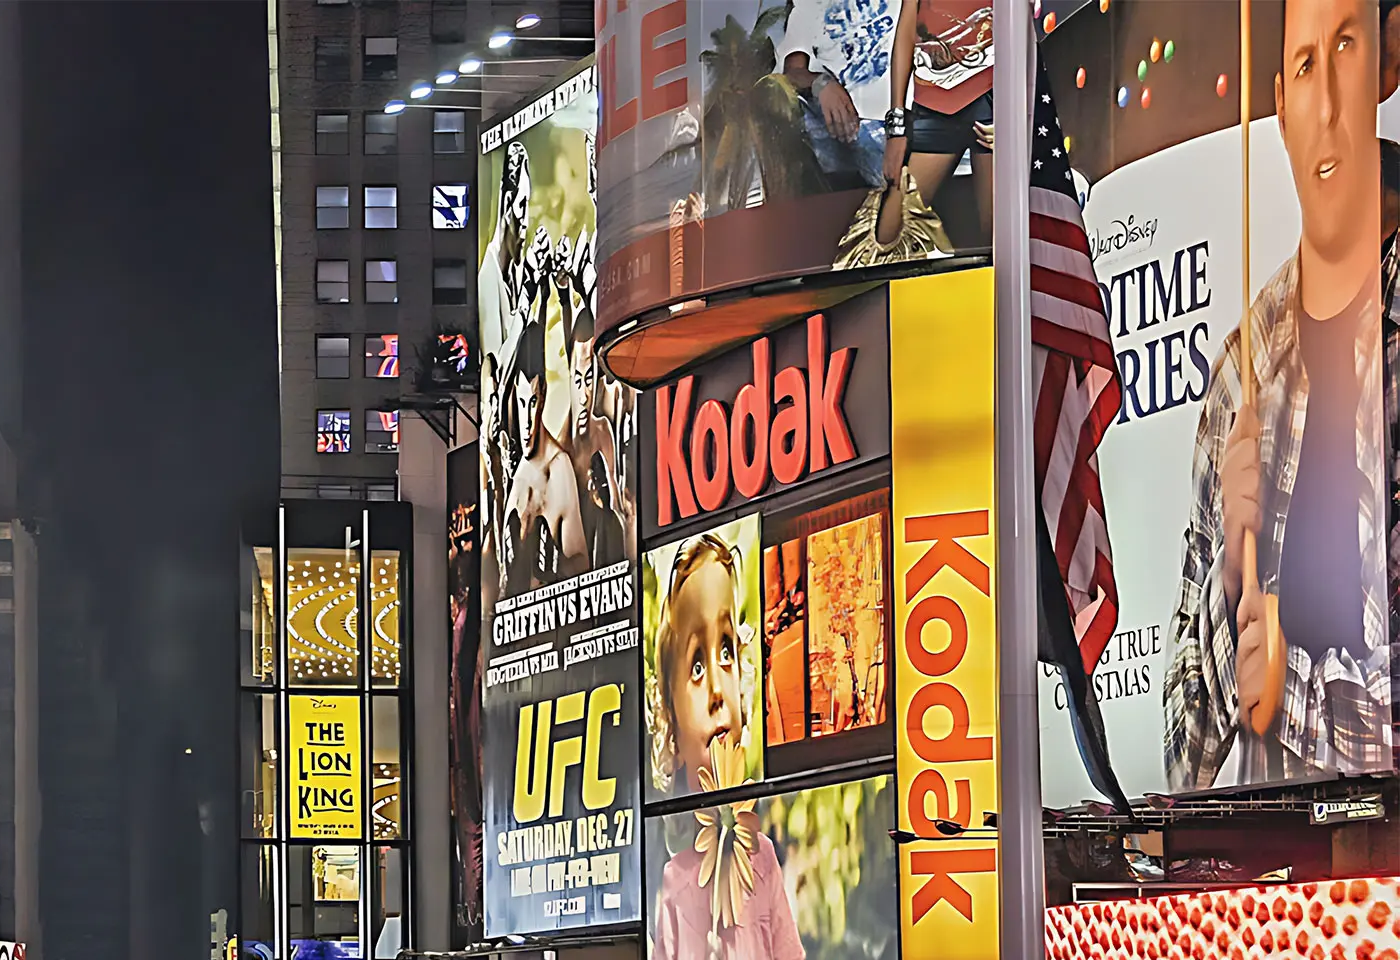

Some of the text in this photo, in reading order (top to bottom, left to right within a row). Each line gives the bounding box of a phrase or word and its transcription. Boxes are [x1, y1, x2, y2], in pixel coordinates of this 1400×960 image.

[1116, 321, 1212, 425] RIES
[655, 313, 858, 527] Kodak
[493, 599, 556, 646] GRIFFIN
[557, 592, 577, 627] VS
[580, 574, 633, 621] EVANS
[1114, 625, 1162, 662] TRUE
[305, 722, 345, 742] THE
[903, 509, 997, 926] Kodak
[298, 747, 352, 781] LION
[513, 683, 621, 823] UFC
[298, 785, 354, 819] KING
[497, 808, 634, 866] SATURDAY, DEC. 27
